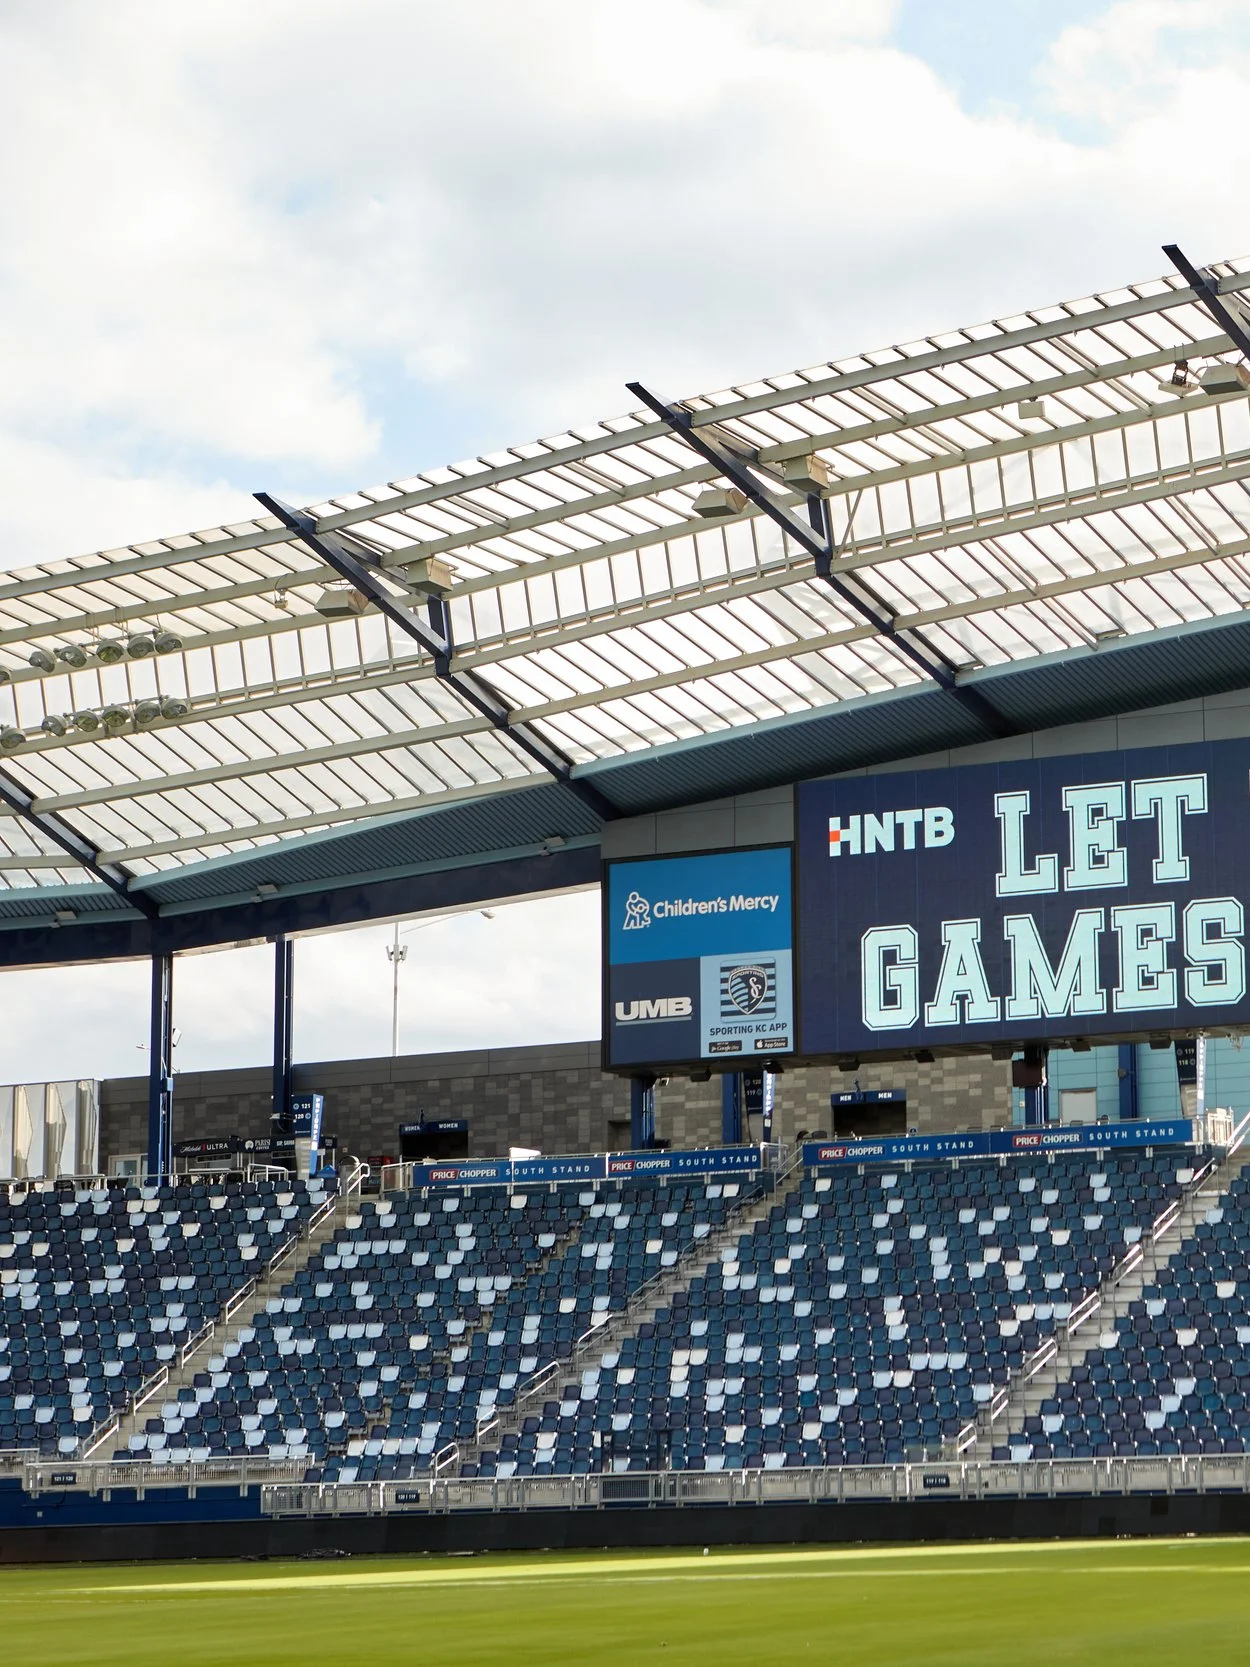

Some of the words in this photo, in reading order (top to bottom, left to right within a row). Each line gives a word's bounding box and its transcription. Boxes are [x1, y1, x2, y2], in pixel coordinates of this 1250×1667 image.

[829, 806, 956, 858] HNTB
[994, 773, 1208, 898] LET
[653, 897, 728, 919] Children's
[729, 894, 780, 913] Mercy
[860, 897, 1247, 1031] GAMES
[615, 996, 693, 1021] UMB
[709, 1025, 753, 1036] SPORTING
[755, 1023, 767, 1033] KC
[769, 1022, 788, 1032] APP
[1015, 1136, 1039, 1146] PRICE
[1042, 1133, 1080, 1143] CHOPPER
[1089, 1131, 1128, 1141] SOUTH
[1135, 1128, 1174, 1138] STAND
[206, 1142, 229, 1151] ULTRA
[821, 1149, 844, 1158] PRICE
[847, 1146, 883, 1156] CHOPPER
[892, 1144, 929, 1153] SOUTH
[936, 1141, 974, 1150] STAND
[432, 1170, 456, 1180] PRICE
[459, 1168, 497, 1178] CHOPPER
[505, 1166, 544, 1176] SOUTH
[552, 1164, 590, 1174] STAND
[611, 1161, 633, 1171] PRICE
[636, 1159, 671, 1169] CHOPPER
[678, 1157, 715, 1167] SOUTH
[721, 1155, 757, 1164] STAND
